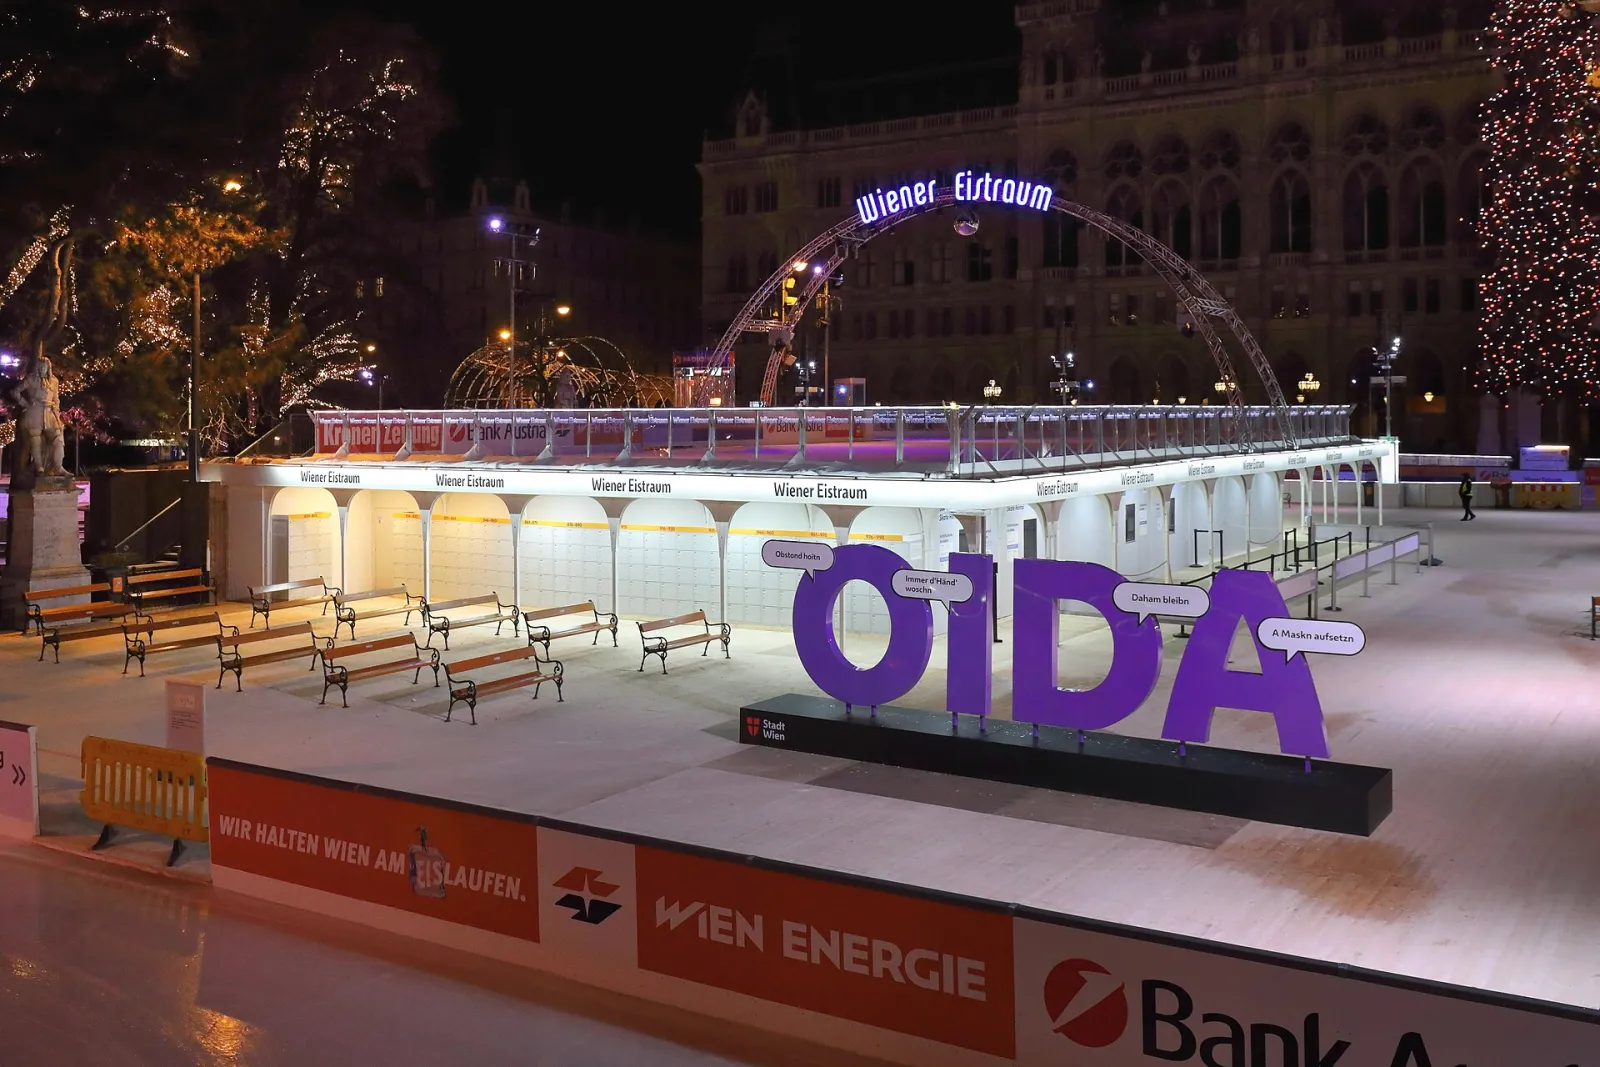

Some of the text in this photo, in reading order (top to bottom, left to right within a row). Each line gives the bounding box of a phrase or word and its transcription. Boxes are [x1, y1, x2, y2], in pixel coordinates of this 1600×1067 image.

[856, 170, 1053, 224] Wiener Eistraum
[383, 421, 440, 447] Zeiung
[503, 422, 547, 441] Austria
[300, 470, 360, 484] Wiener Eistraum
[1188, 462, 1215, 476] Wiener Eistraum
[435, 473, 504, 488] Wiener Eistraum
[591, 477, 671, 493] Wiener Eistraum
[1121, 470, 1154, 486] Wiener Eistraum
[773, 482, 867, 500] Wiener Eistraum
[1036, 479, 1079, 497] Wiener Eistraum
[775, 550, 821, 561] Obstond hoitn
[905, 575, 928, 585] Immer
[905, 586, 932, 594] woschn
[1131, 593, 1190, 606] Daham bleibn
[1272, 629, 1354, 643] A Maskn aufsetzn
[792, 543, 1331, 759] OIDA
[763, 719, 786, 731] Stadt
[763, 729, 785, 741] Wien
[219, 814, 251, 841] WIR
[255, 823, 320, 853] HALTEN
[324, 836, 370, 867] WIEN
[373, 849, 405, 875] AM
[655, 895, 987, 1002] WIEN ENERGIE
[1141, 979, 1352, 1067] Bank
